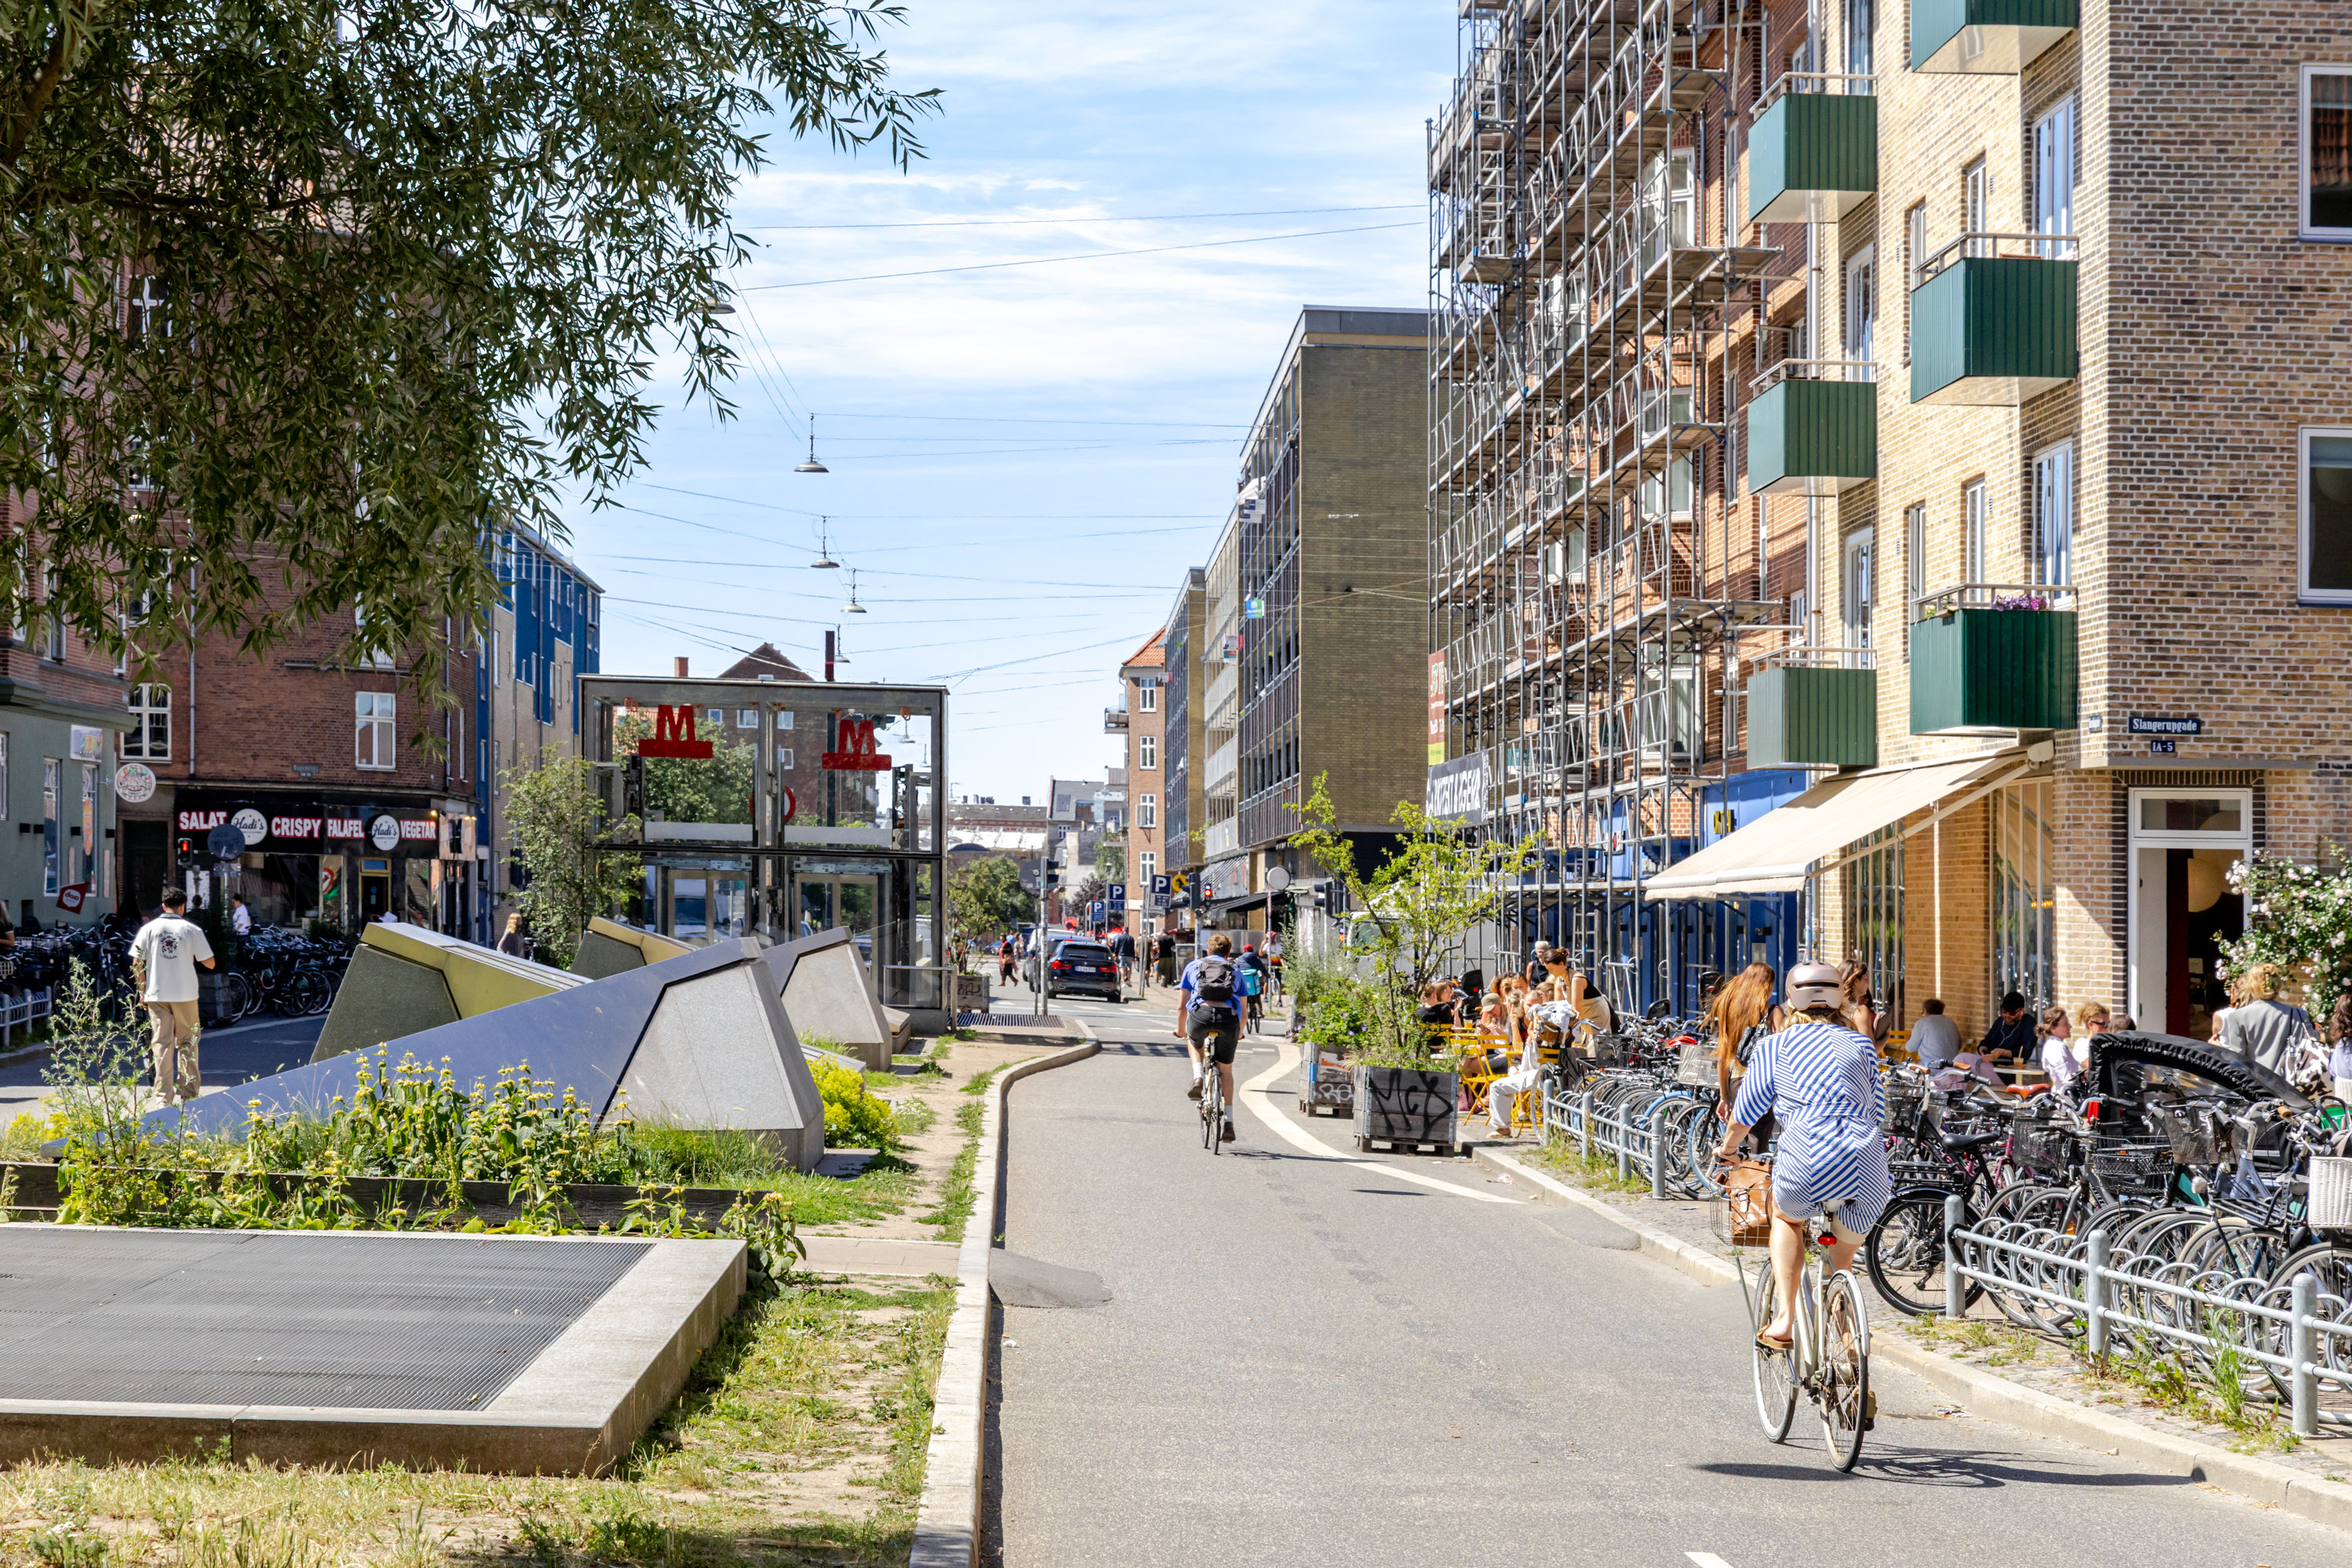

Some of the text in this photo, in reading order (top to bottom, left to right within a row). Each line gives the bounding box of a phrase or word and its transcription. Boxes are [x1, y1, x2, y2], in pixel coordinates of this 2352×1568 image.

[655, 704, 696, 742] M
[2132, 718, 2198, 733] Slangerupgade
[837, 719, 877, 755] M
[2152, 742, 2173, 752] 1A-5
[180, 811, 227, 830] SALAT
[271, 817, 322, 838] CRISPY
[326, 818, 365, 839] FALAFEL
[372, 822, 397, 837] Hadi's
[401, 820, 437, 840] VEGETAR
[1112, 885, 1123, 898] P
[1155, 877, 1167, 892] P
[65, 891, 79, 901] dao
[1094, 902, 1102, 913] P
